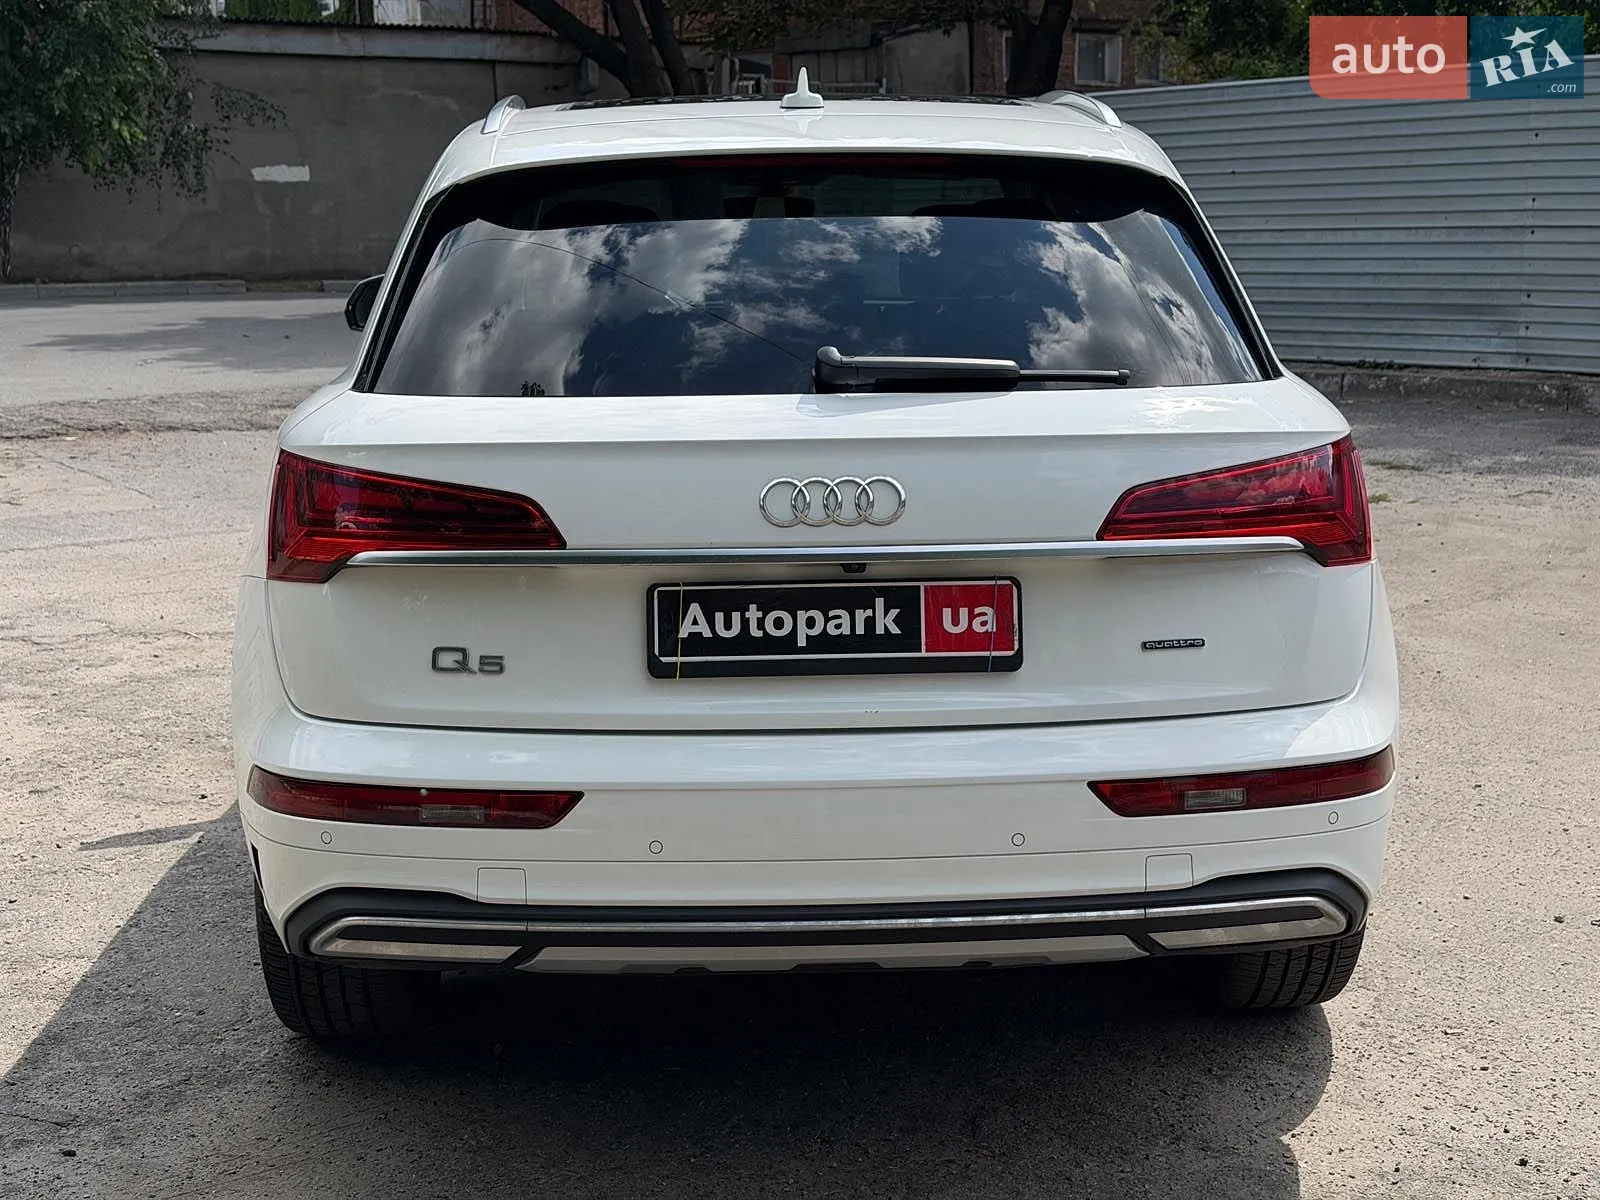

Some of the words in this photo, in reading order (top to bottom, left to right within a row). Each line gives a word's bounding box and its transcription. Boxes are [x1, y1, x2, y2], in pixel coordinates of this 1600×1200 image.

[679, 597, 902, 647] Autopark
[942, 605, 997, 635] ua
[1143, 638, 1204, 650] quattro
[431, 646, 505, 674] Q5
